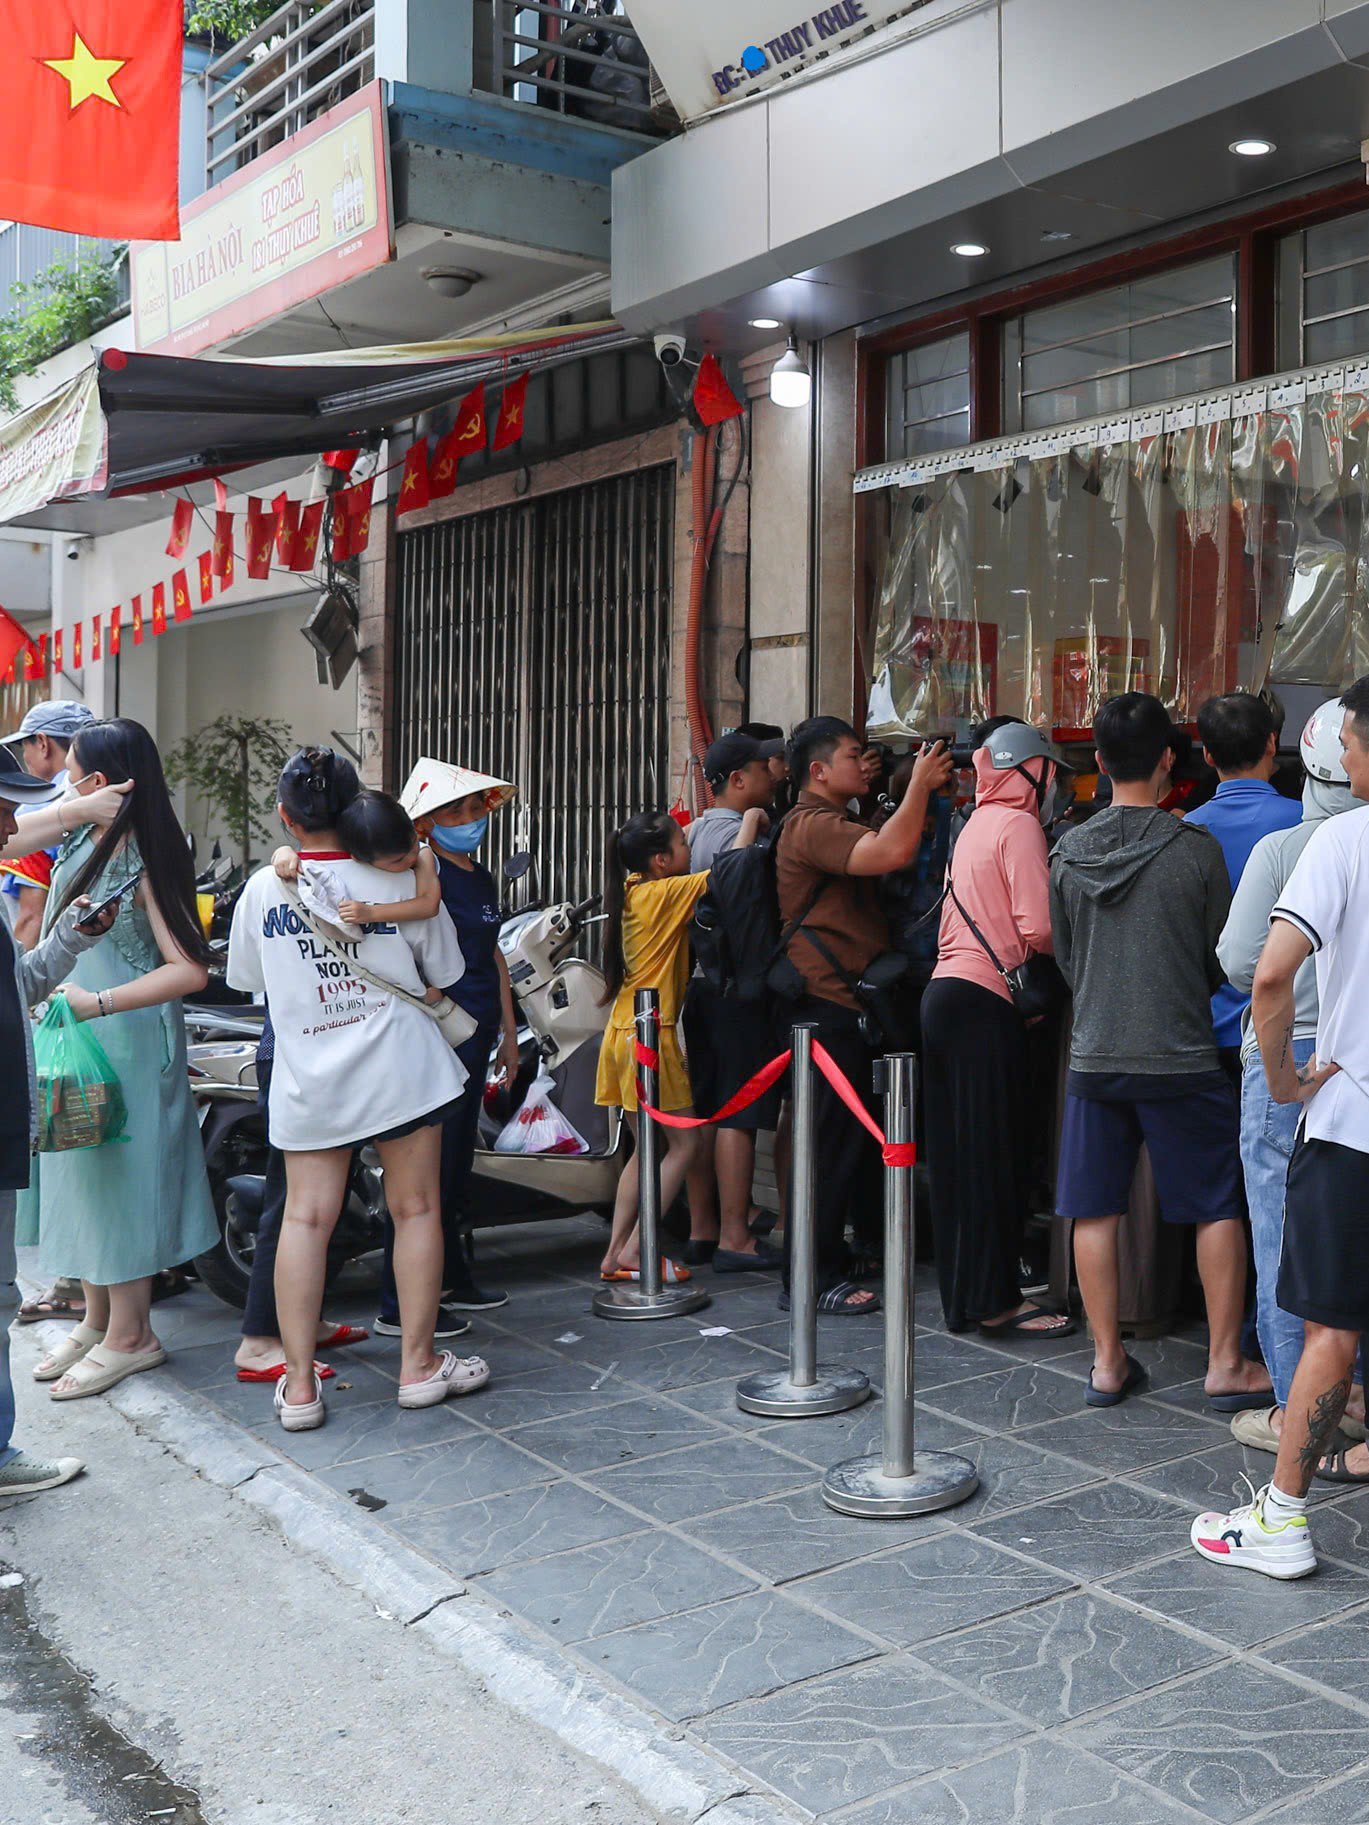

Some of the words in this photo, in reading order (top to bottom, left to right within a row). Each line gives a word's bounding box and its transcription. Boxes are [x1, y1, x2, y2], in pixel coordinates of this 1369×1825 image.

[262, 186, 280, 228] TẠP
[281, 163, 304, 211] HÓA
[172, 258, 195, 300] BIA
[196, 234, 217, 287] HÀ
[218, 223, 245, 276] NỘI
[316, 977, 367, 1004] 1995
[324, 1004, 333, 1015] IT
[335, 1002, 345, 1013] IS
[346, 997, 367, 1011] JUST
[313, 1013, 366, 1036] particular
